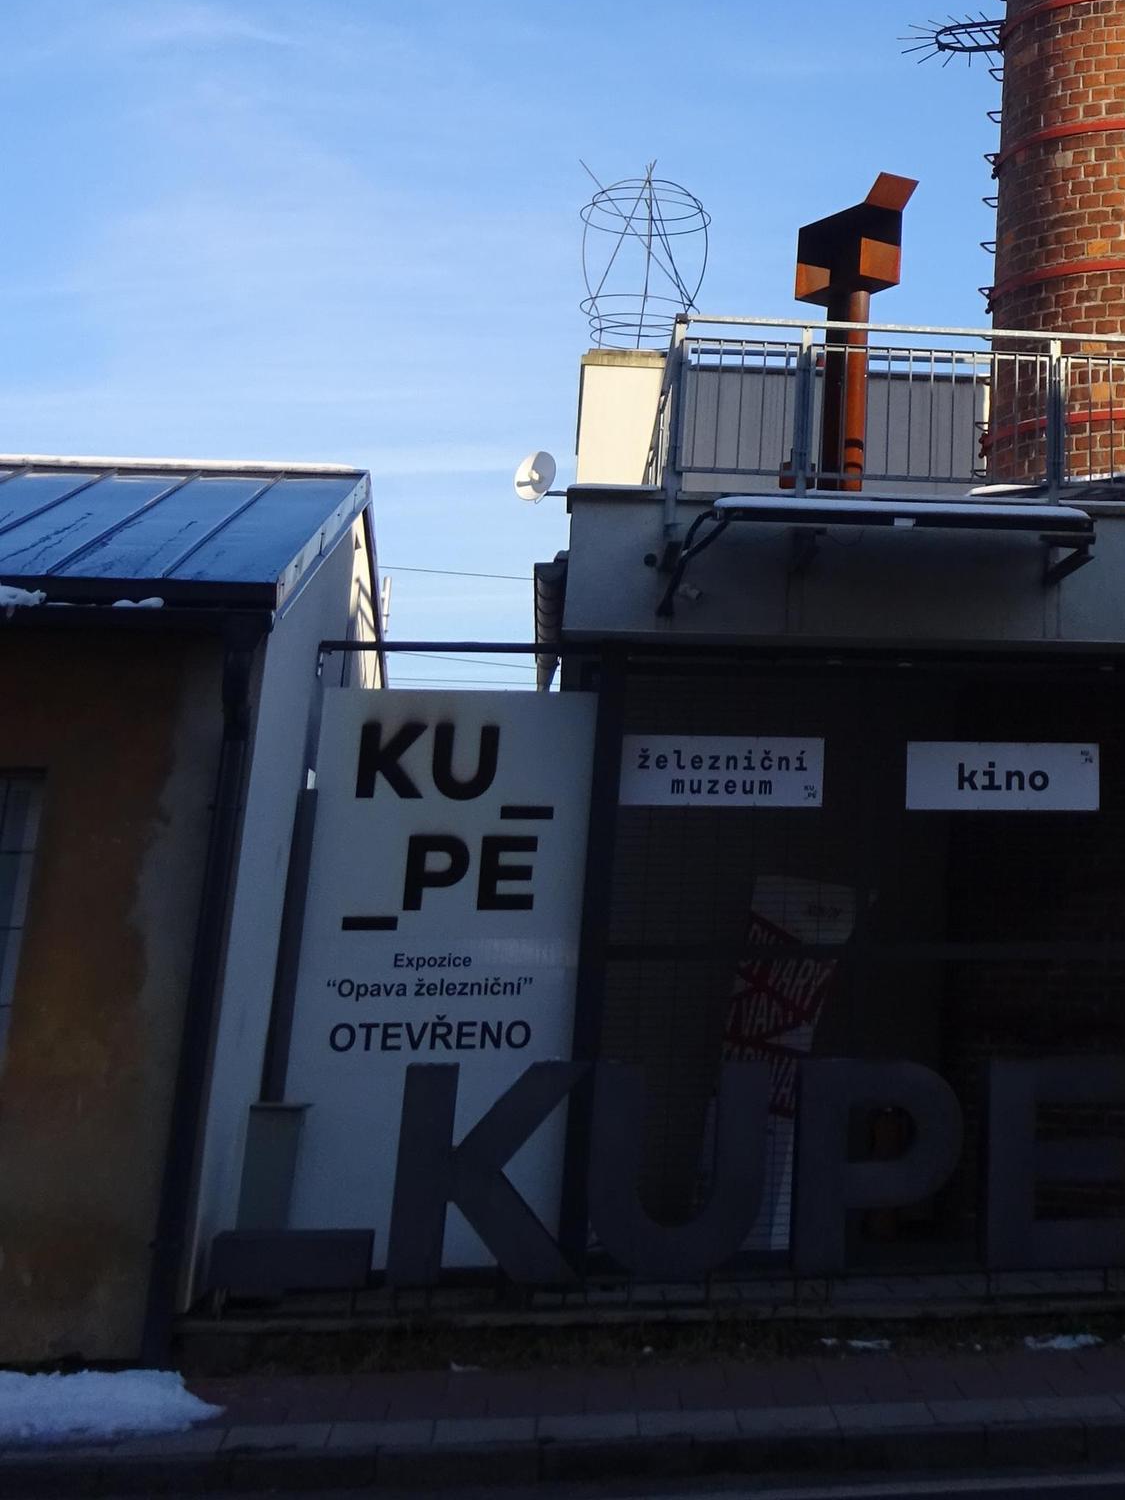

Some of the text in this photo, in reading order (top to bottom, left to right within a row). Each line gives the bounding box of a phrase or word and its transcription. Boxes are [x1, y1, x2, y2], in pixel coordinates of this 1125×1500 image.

[637, 748, 808, 771] železniční
[671, 778, 773, 795] muzeum
[957, 761, 1049, 791] kino
[393, 952, 472, 972] Expozice
[329, 1014, 532, 1053] OTEVŘENO
